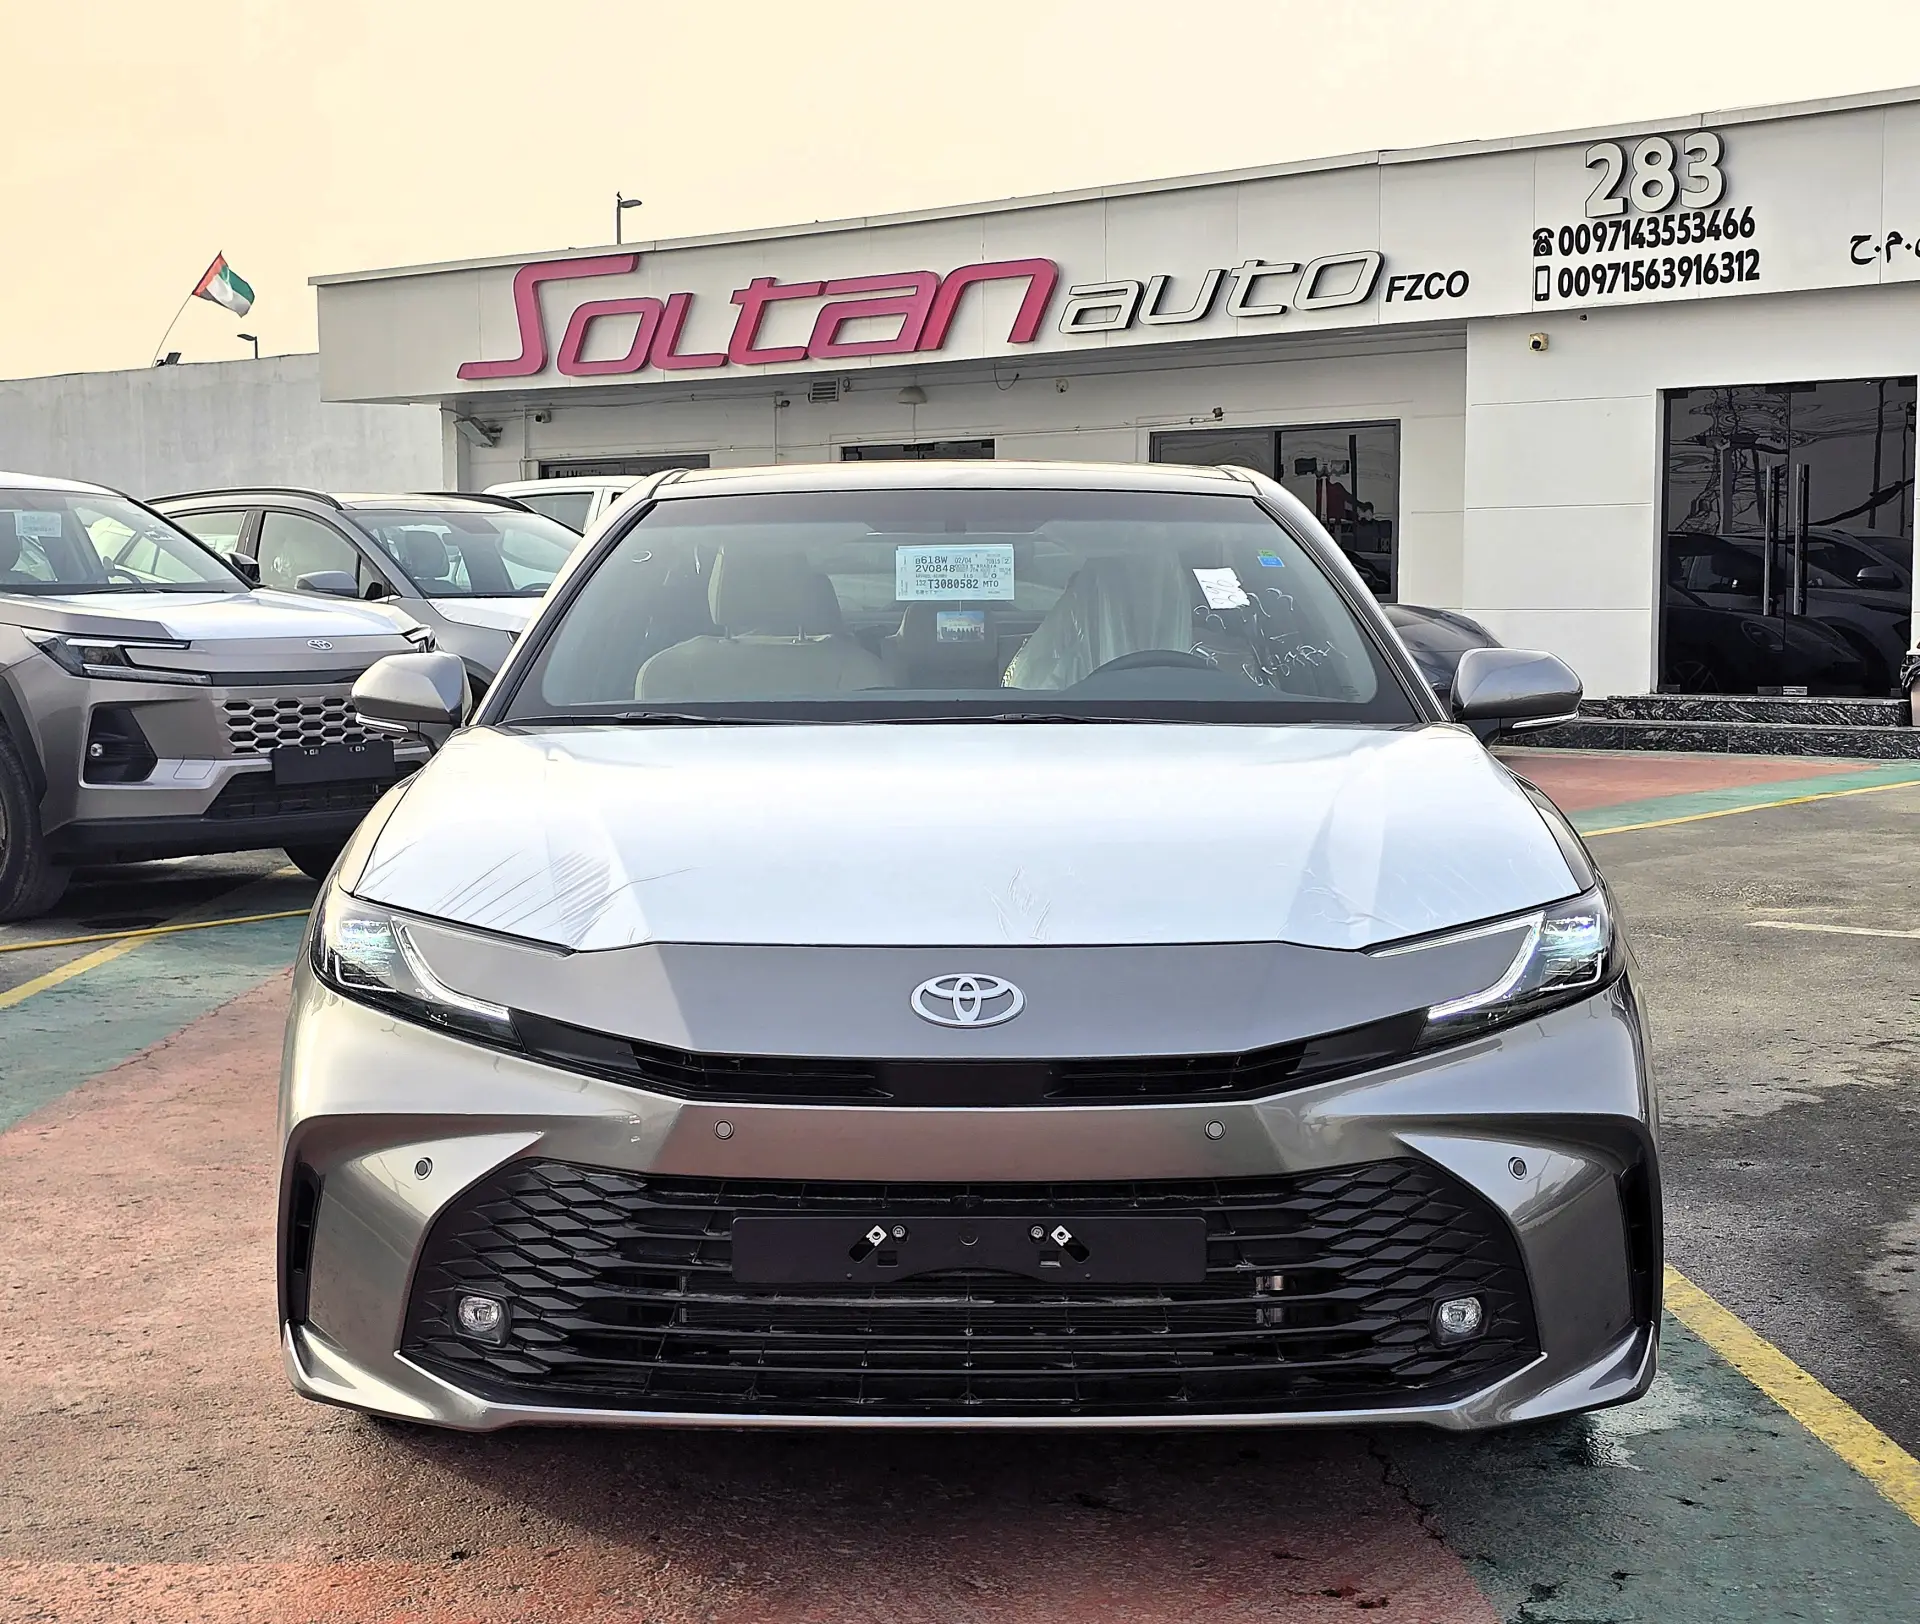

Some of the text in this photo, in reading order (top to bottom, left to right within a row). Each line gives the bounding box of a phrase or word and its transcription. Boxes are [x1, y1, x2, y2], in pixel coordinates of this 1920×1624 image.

[1585, 131, 1728, 218] 283
[1558, 206, 1755, 256] 0097143553466
[1558, 248, 1760, 298] 00971563916312
[456, 250, 1470, 380] Soltan auto FZCO
[928, 579, 979, 589] T3080582
